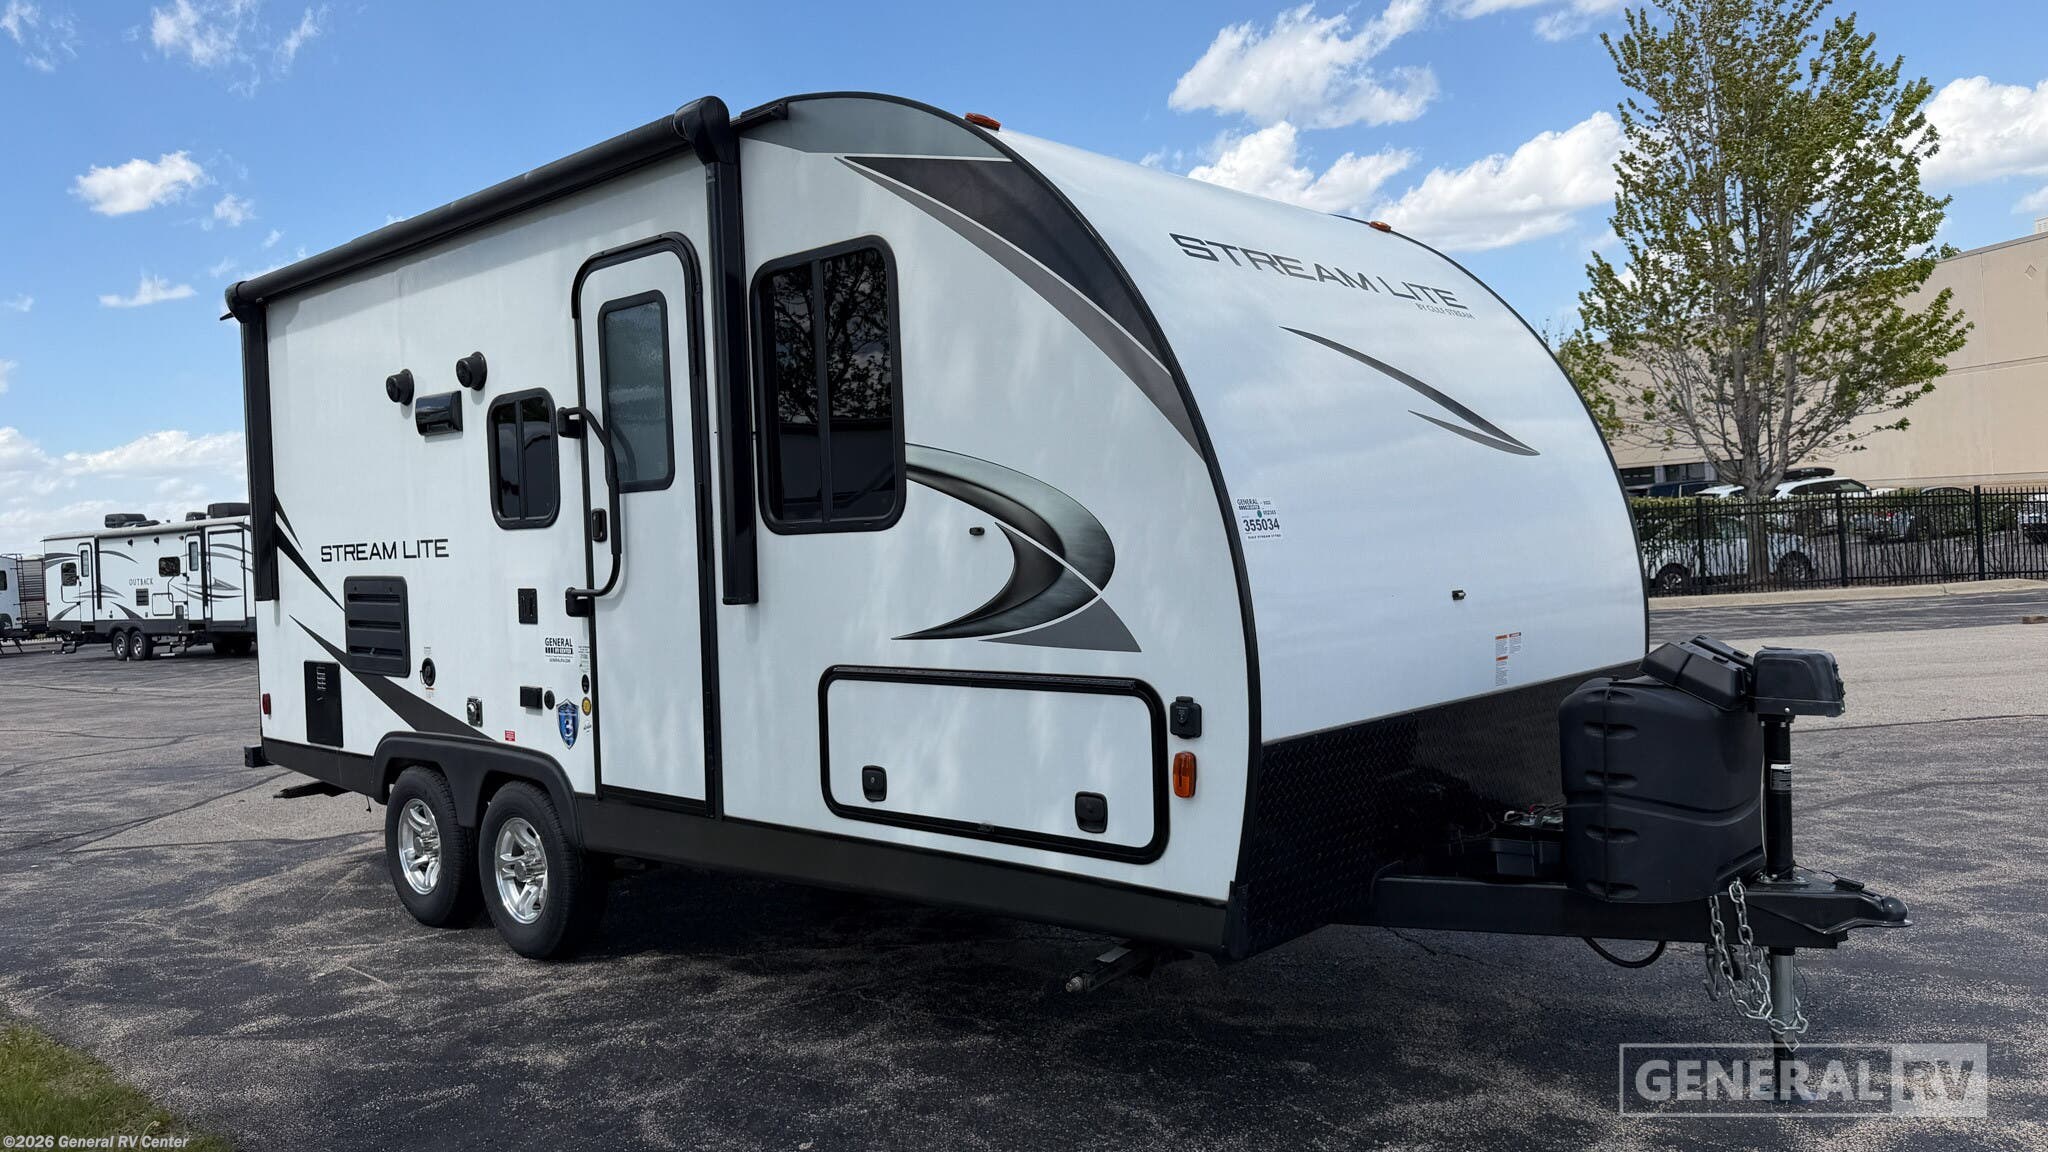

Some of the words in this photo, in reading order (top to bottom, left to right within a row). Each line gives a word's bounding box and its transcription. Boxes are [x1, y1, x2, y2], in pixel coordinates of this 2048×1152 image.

[1168, 232, 1379, 293] STREAM
[1377, 276, 1468, 310] LITE
[1243, 518, 1280, 532] 355034
[320, 541, 397, 562] STREAM
[402, 538, 449, 559] LITE
[544, 637, 573, 647] GENERAL
